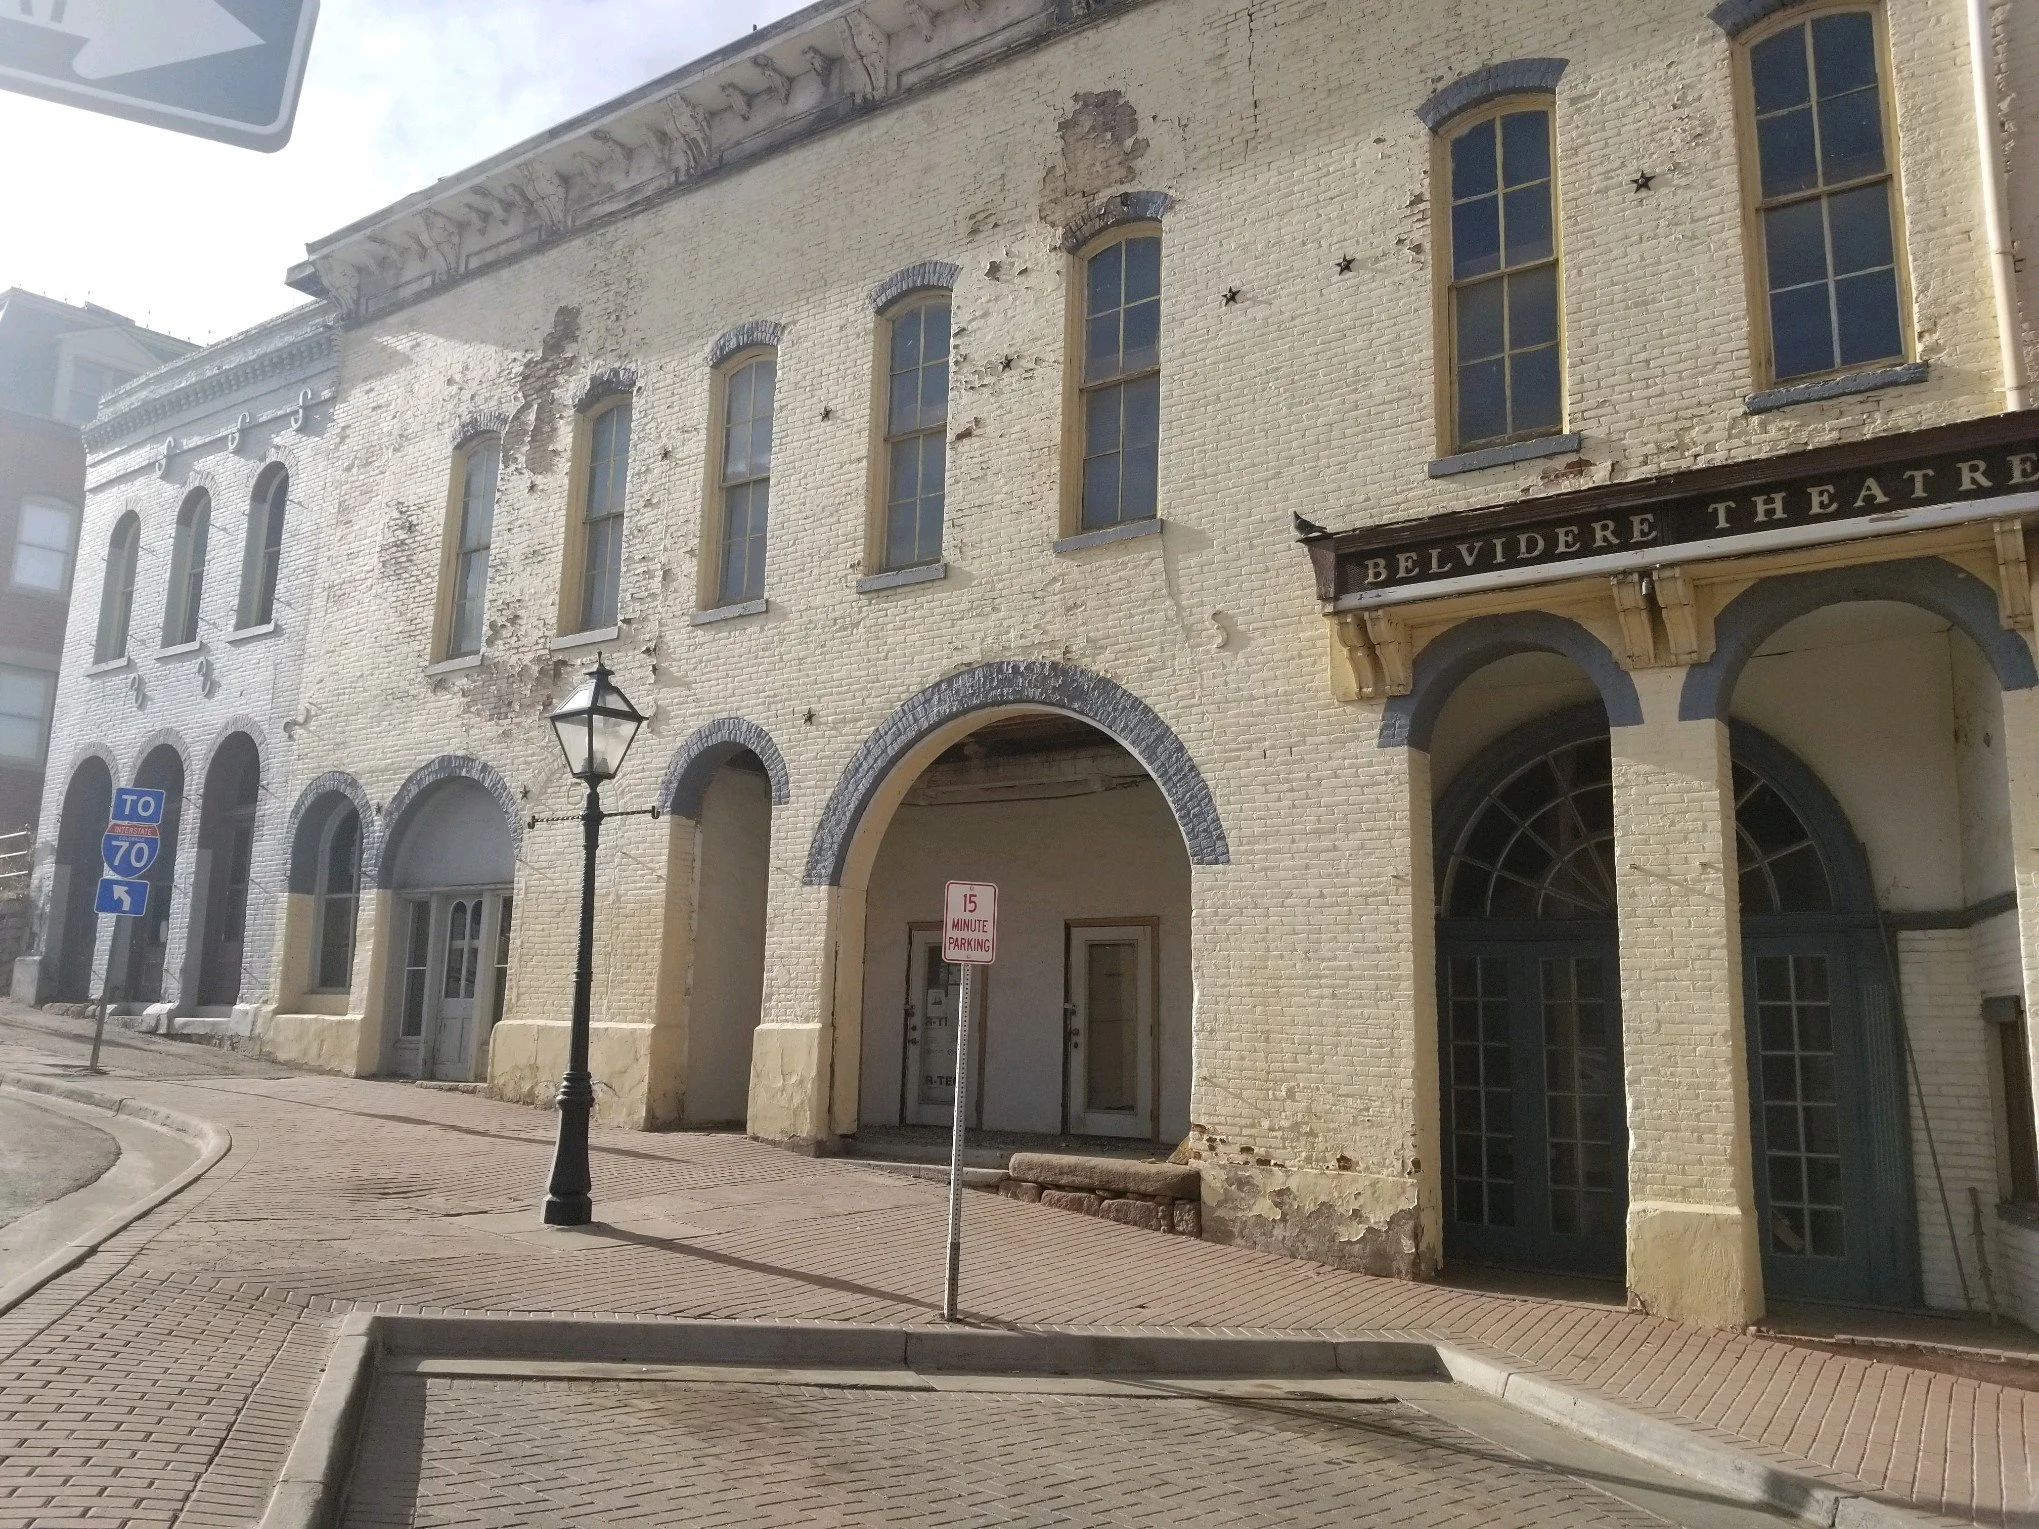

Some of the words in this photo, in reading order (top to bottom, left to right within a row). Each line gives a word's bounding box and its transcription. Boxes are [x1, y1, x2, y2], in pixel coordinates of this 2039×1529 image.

[1364, 513, 1658, 584] BELVIDERE
[1708, 452, 2039, 529] THEATRE
[121, 794, 155, 817] TO
[114, 825, 152, 836] INTERSTATE
[111, 840, 149, 868] 70
[963, 893, 977, 913] 15
[952, 918, 989, 933] MINUTE
[948, 937, 991, 953] PARKING
